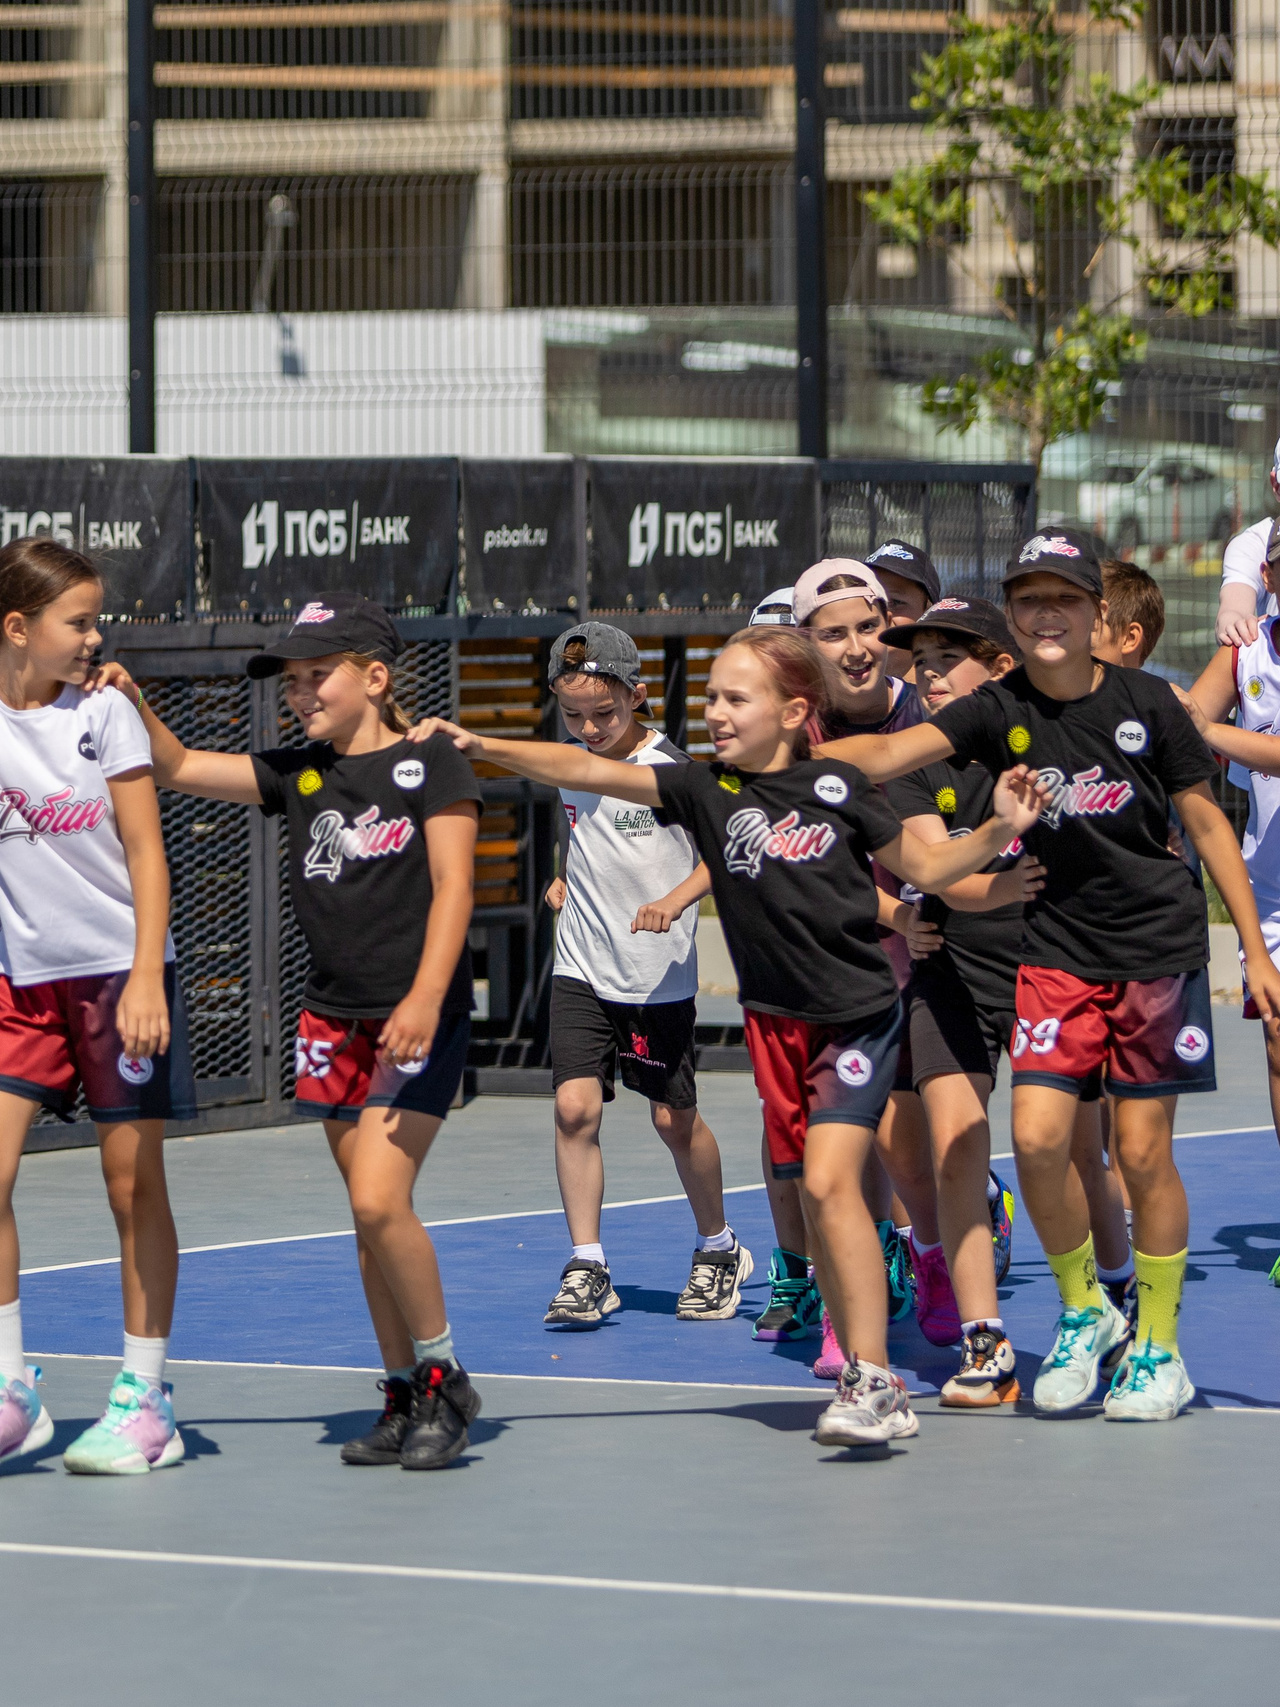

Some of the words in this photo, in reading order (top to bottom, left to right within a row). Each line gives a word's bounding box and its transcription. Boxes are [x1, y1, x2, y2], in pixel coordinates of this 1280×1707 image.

[88, 521, 142, 549] БАНК
[284, 508, 348, 557] ПСБ
[360, 516, 410, 546] БАНК
[664, 510, 723, 558] ПСБ
[733, 520, 780, 548] БАНК
[1119, 731, 1142, 741] РФБ
[397, 767, 421, 777] РФБ
[819, 784, 843, 794] РФБ
[615, 810, 631, 821] L.A.
[628, 820, 656, 829] MATCH
[638, 829, 653, 837] LEAGUE
[304, 804, 415, 883] Рубин
[723, 807, 837, 879] Рубин
[1013, 1017, 1061, 1059] 69
